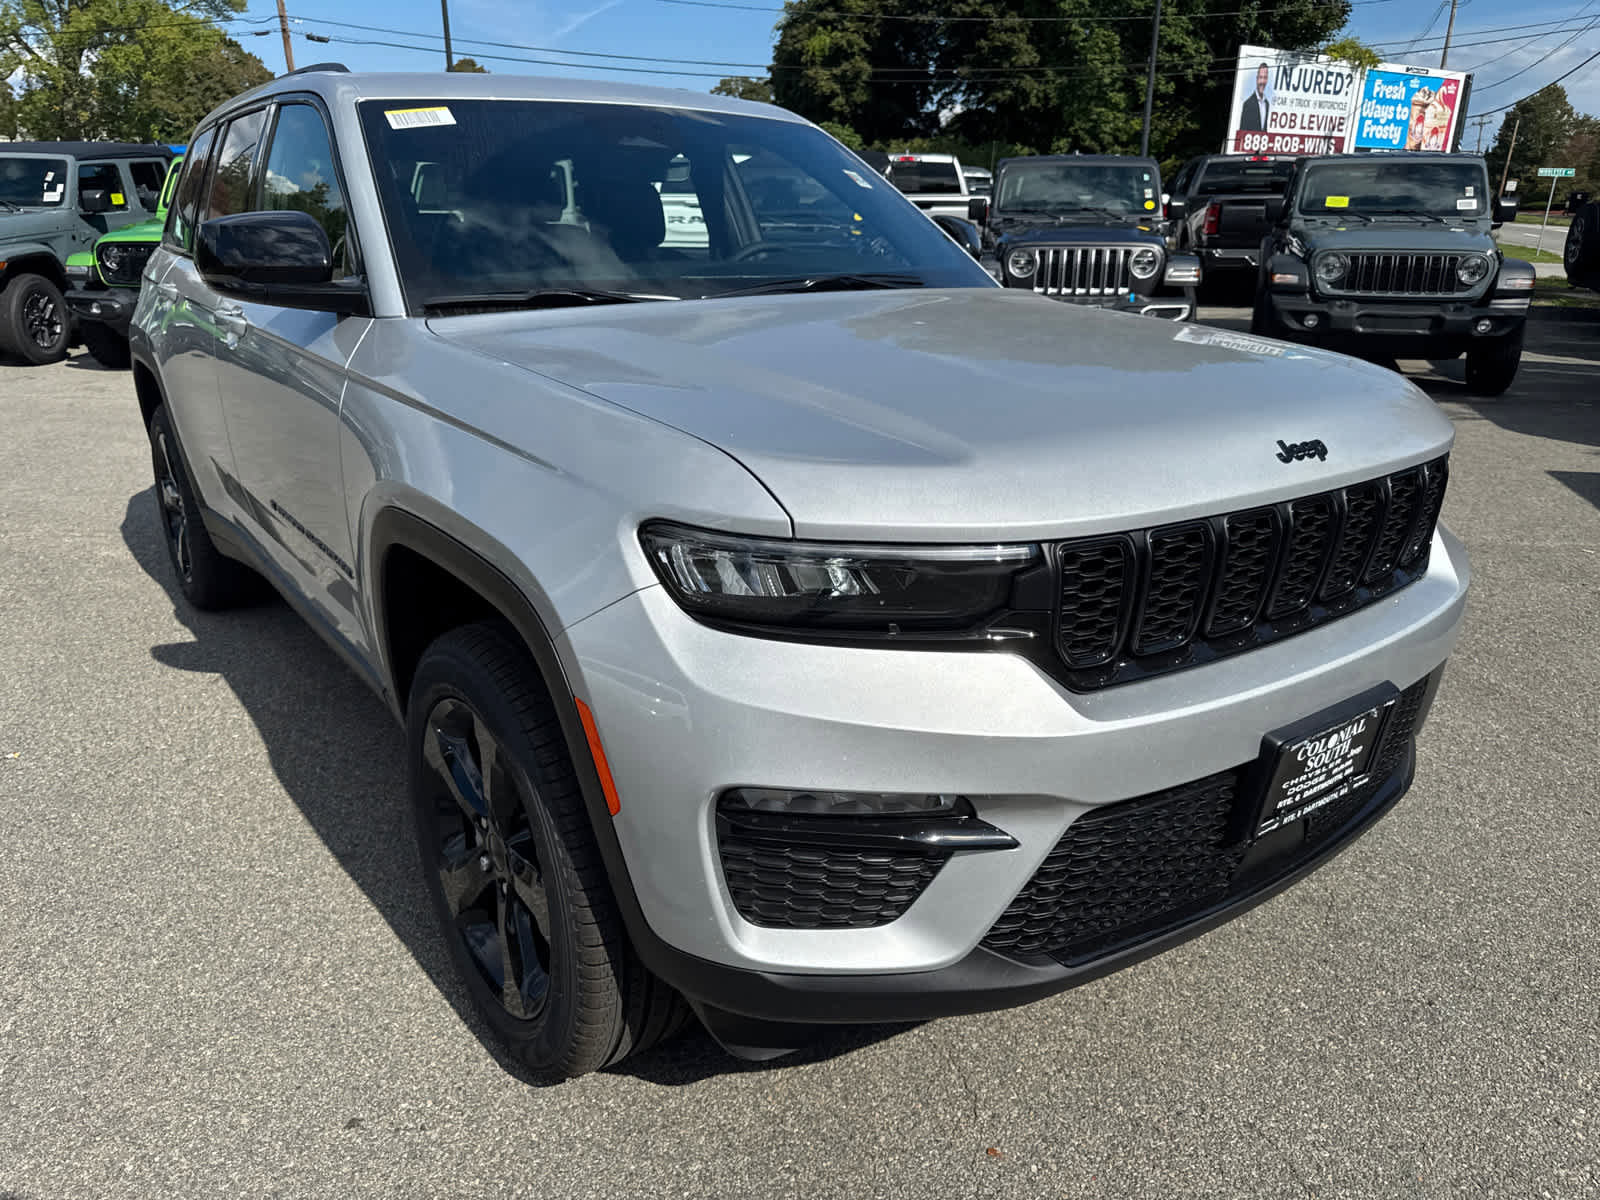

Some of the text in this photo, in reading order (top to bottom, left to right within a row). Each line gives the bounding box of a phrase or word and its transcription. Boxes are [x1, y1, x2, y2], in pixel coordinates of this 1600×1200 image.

[1273, 65, 1353, 96] INJURED?
[1373, 79, 1406, 100] Fresh
[1270, 111, 1345, 132] ROB LEVINE
[1362, 99, 1409, 124] Ways to
[1243, 133, 1336, 154] 888-ROB-WINS
[1362, 119, 1402, 145] Frosty
[1275, 438, 1328, 464] Jeep
[1297, 718, 1367, 761] COLONIAL
[1304, 738, 1352, 772] SOUTH
[1282, 758, 1342, 789] CHRYSLER
[1287, 773, 1327, 796] DODGE
